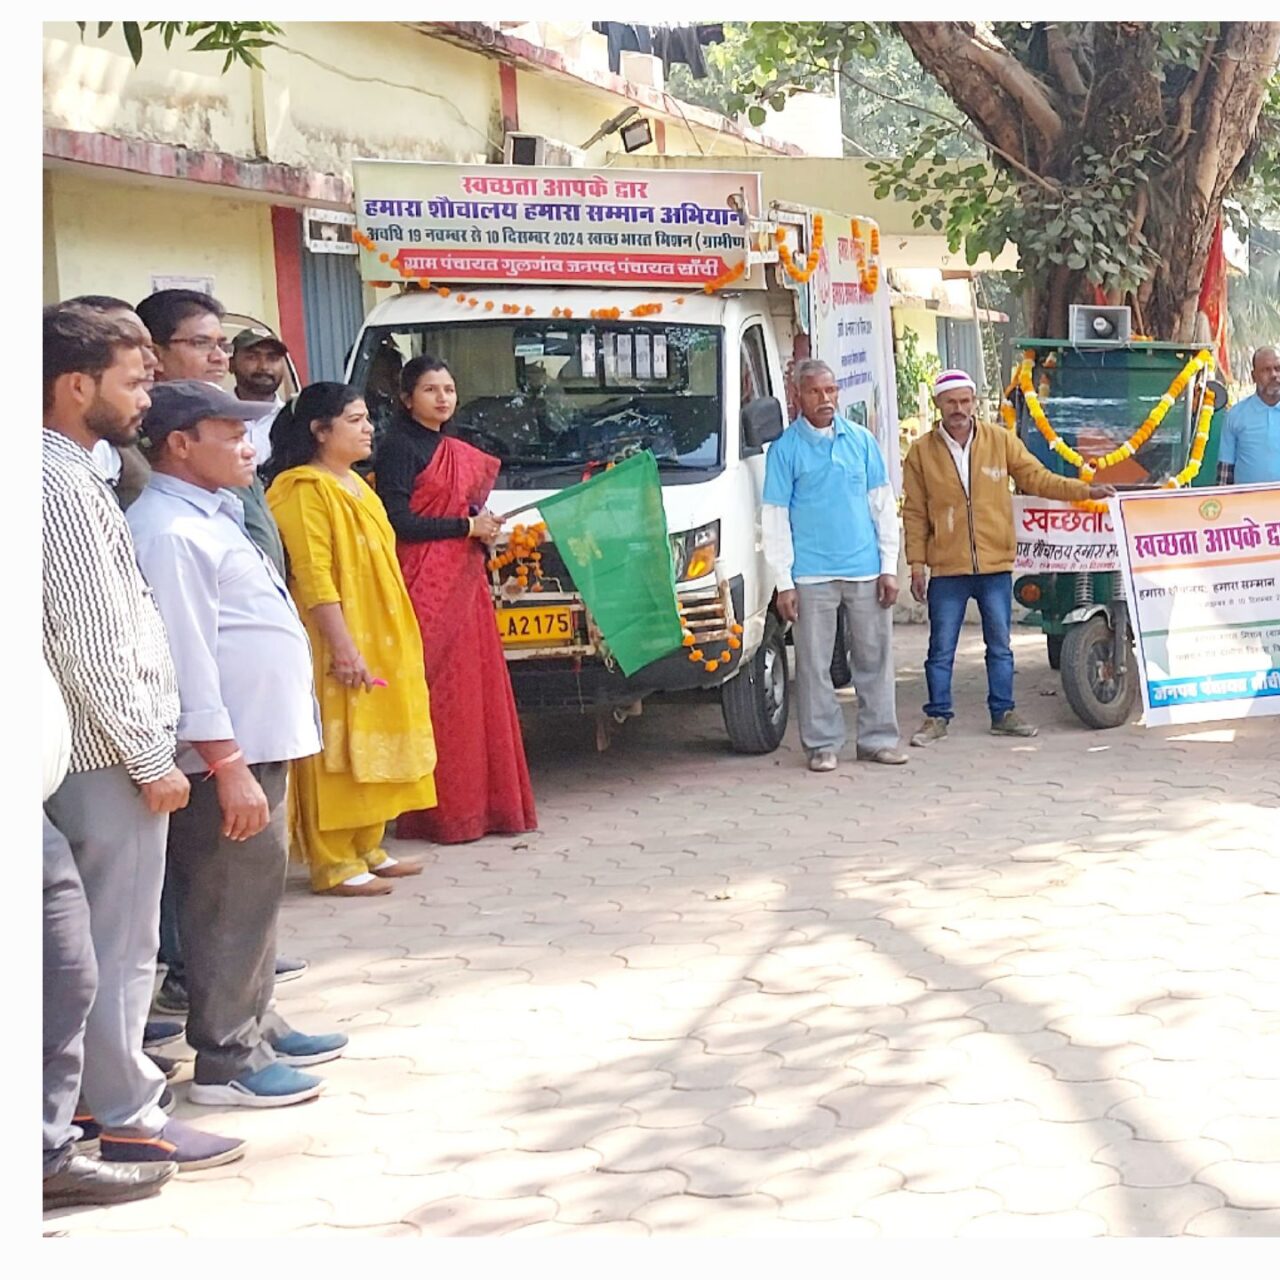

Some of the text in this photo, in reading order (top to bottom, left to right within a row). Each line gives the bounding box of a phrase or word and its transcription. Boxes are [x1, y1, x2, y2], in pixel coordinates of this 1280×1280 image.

[462, 175, 648, 198] स्वच्छता आपके द्वार
[364, 196, 745, 226] हमारा शौचालय हमारा सम्मान अभियान
[367, 224, 403, 241] अवधि
[408, 228, 421, 242] 19
[425, 228, 468, 243] नवम्बर
[470, 225, 482, 242] से
[486, 230, 499, 244] 10
[502, 226, 551, 244] दिसम्बर
[554, 232, 583, 246] 2024
[588, 232, 619, 246] स्वच्छ
[621, 232, 652, 247] भारत
[655, 231, 692, 248] मिशन
[404, 256, 437, 270] ग्राम
[440, 254, 499, 271] पंचायत
[566, 260, 617, 276] जनपद
[617, 258, 674, 275] पंचायत
[1023, 508, 1103, 533] स्वच्छता
[1134, 530, 1198, 558] स्वच्छता
[1203, 517, 1262, 553] आपके
[1139, 587, 1166, 601] हमारा
[1213, 579, 1239, 593] हमारा
[1241, 576, 1275, 590] सम्मान
[500, 613, 569, 636] A2175
